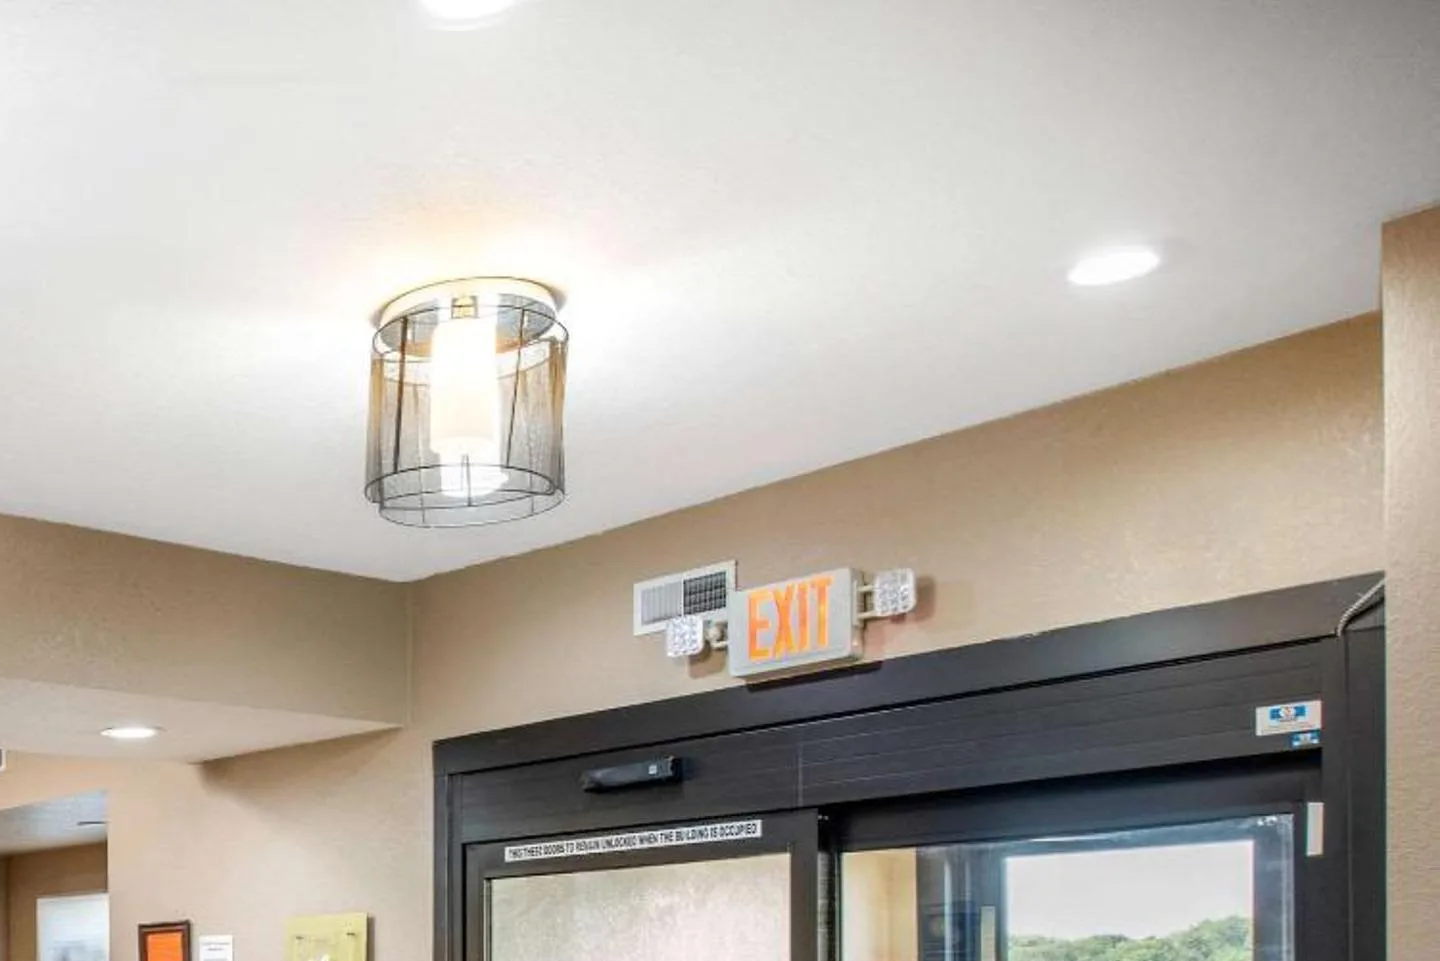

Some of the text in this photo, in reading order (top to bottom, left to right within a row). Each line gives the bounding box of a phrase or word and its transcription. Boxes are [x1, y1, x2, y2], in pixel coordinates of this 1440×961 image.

[747, 576, 833, 662] EXIT
[601, 836, 636, 849] UNLOCKED
[638, 833, 660, 845] WHEN
[661, 831, 676, 842] THE
[677, 828, 710, 841] BUILDING
[721, 823, 758, 836] OCCUPIED
